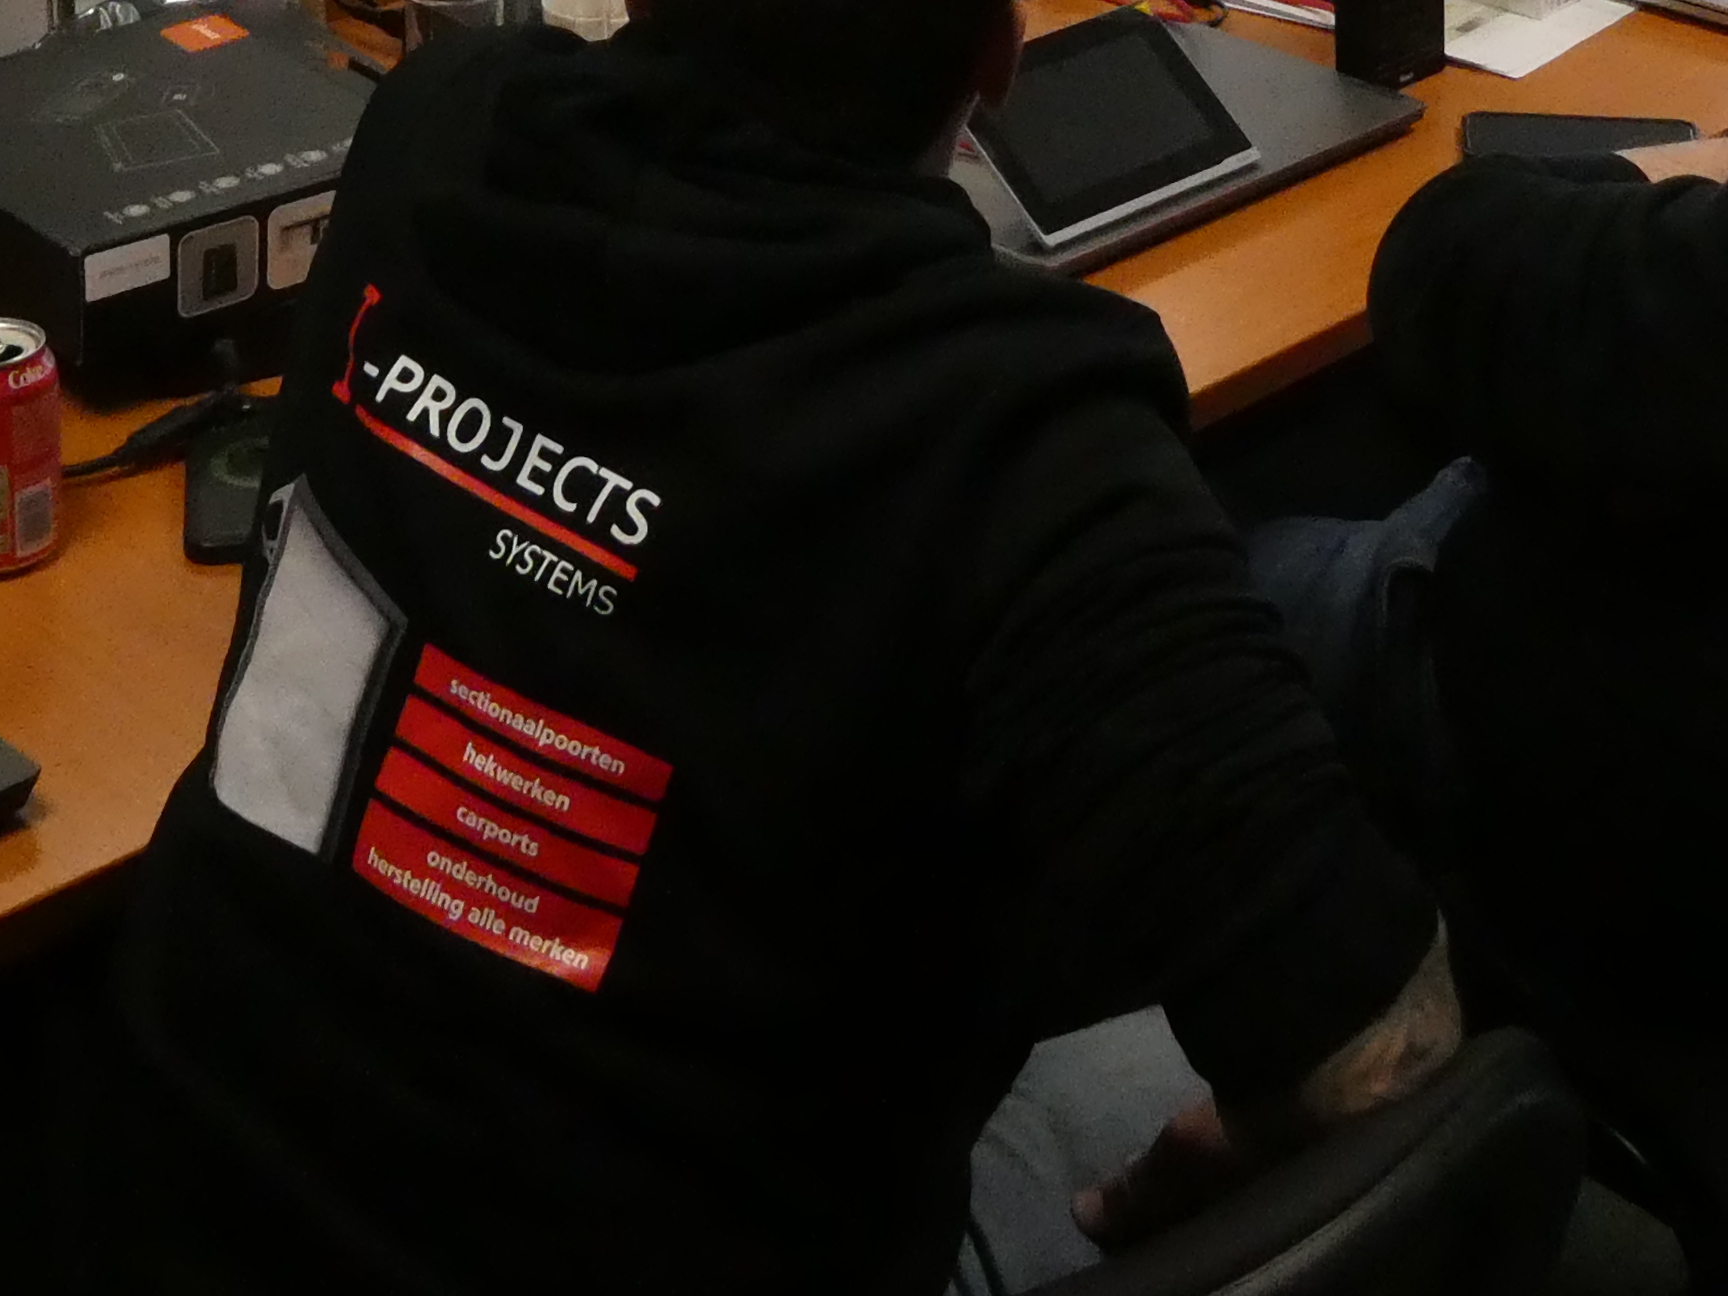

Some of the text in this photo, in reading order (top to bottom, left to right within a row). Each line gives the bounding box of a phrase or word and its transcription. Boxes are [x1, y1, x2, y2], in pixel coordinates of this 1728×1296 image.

[488, 528, 618, 615] SYSTEMS
[449, 678, 625, 775] sectionaalpoorten
[462, 741, 571, 811] hekwerken
[456, 806, 539, 857] carports
[367, 846, 590, 970] herstelling alle merken
[426, 851, 540, 914] onderhoud
